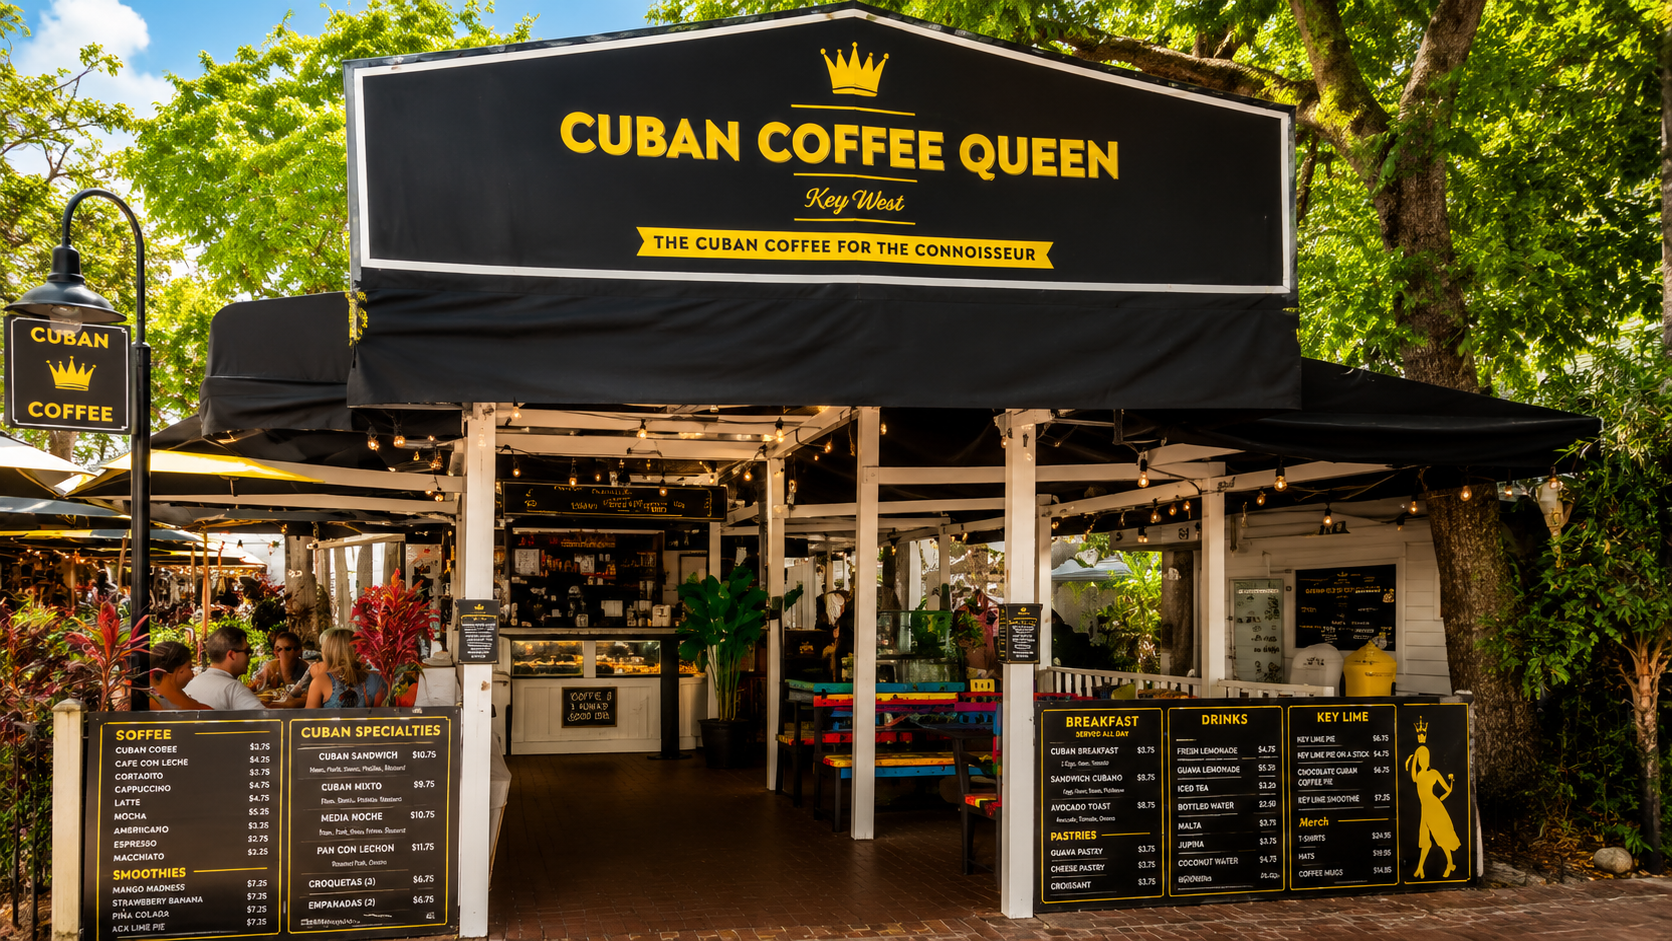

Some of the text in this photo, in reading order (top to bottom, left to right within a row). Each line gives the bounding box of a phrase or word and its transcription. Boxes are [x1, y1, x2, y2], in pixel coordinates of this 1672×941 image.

[561, 112, 1118, 180] CUBAN COFFEE QUEEN
[805, 188, 904, 214] Key West
[654, 235, 1036, 261] THE CUBAN COFFEE FOR THE CONNOISSEUR
[31, 327, 108, 349] CUBAN
[28, 402, 113, 422] COFFEE
[1066, 716, 1139, 727] BREAKFAST
[1202, 714, 1247, 724] DRINKS
[1318, 712, 1368, 722] KEY LIME
[116, 729, 171, 740] SOFFEE
[301, 725, 440, 738] CUBAN SPECIALTIES
[352, 751, 397, 759] SANDWICH
[250, 768, 270, 776] $3.75
[322, 783, 351, 791] CUBAN
[321, 814, 349, 822] MEDIA
[352, 813, 382, 821] NOCHE
[1299, 817, 1328, 827] Merch
[1051, 831, 1096, 841] PASTRIES
[338, 846, 356, 854] CON
[412, 843, 434, 851] $11.75
[114, 853, 164, 861] MACCHIATO
[113, 867, 186, 880] SMOOTHIES
[309, 875, 434, 887] CROQUETAS (3) $6.75
[146, 884, 185, 892] MADNESS
[169, 896, 203, 904] BANANA
[413, 895, 434, 903] $6.75
